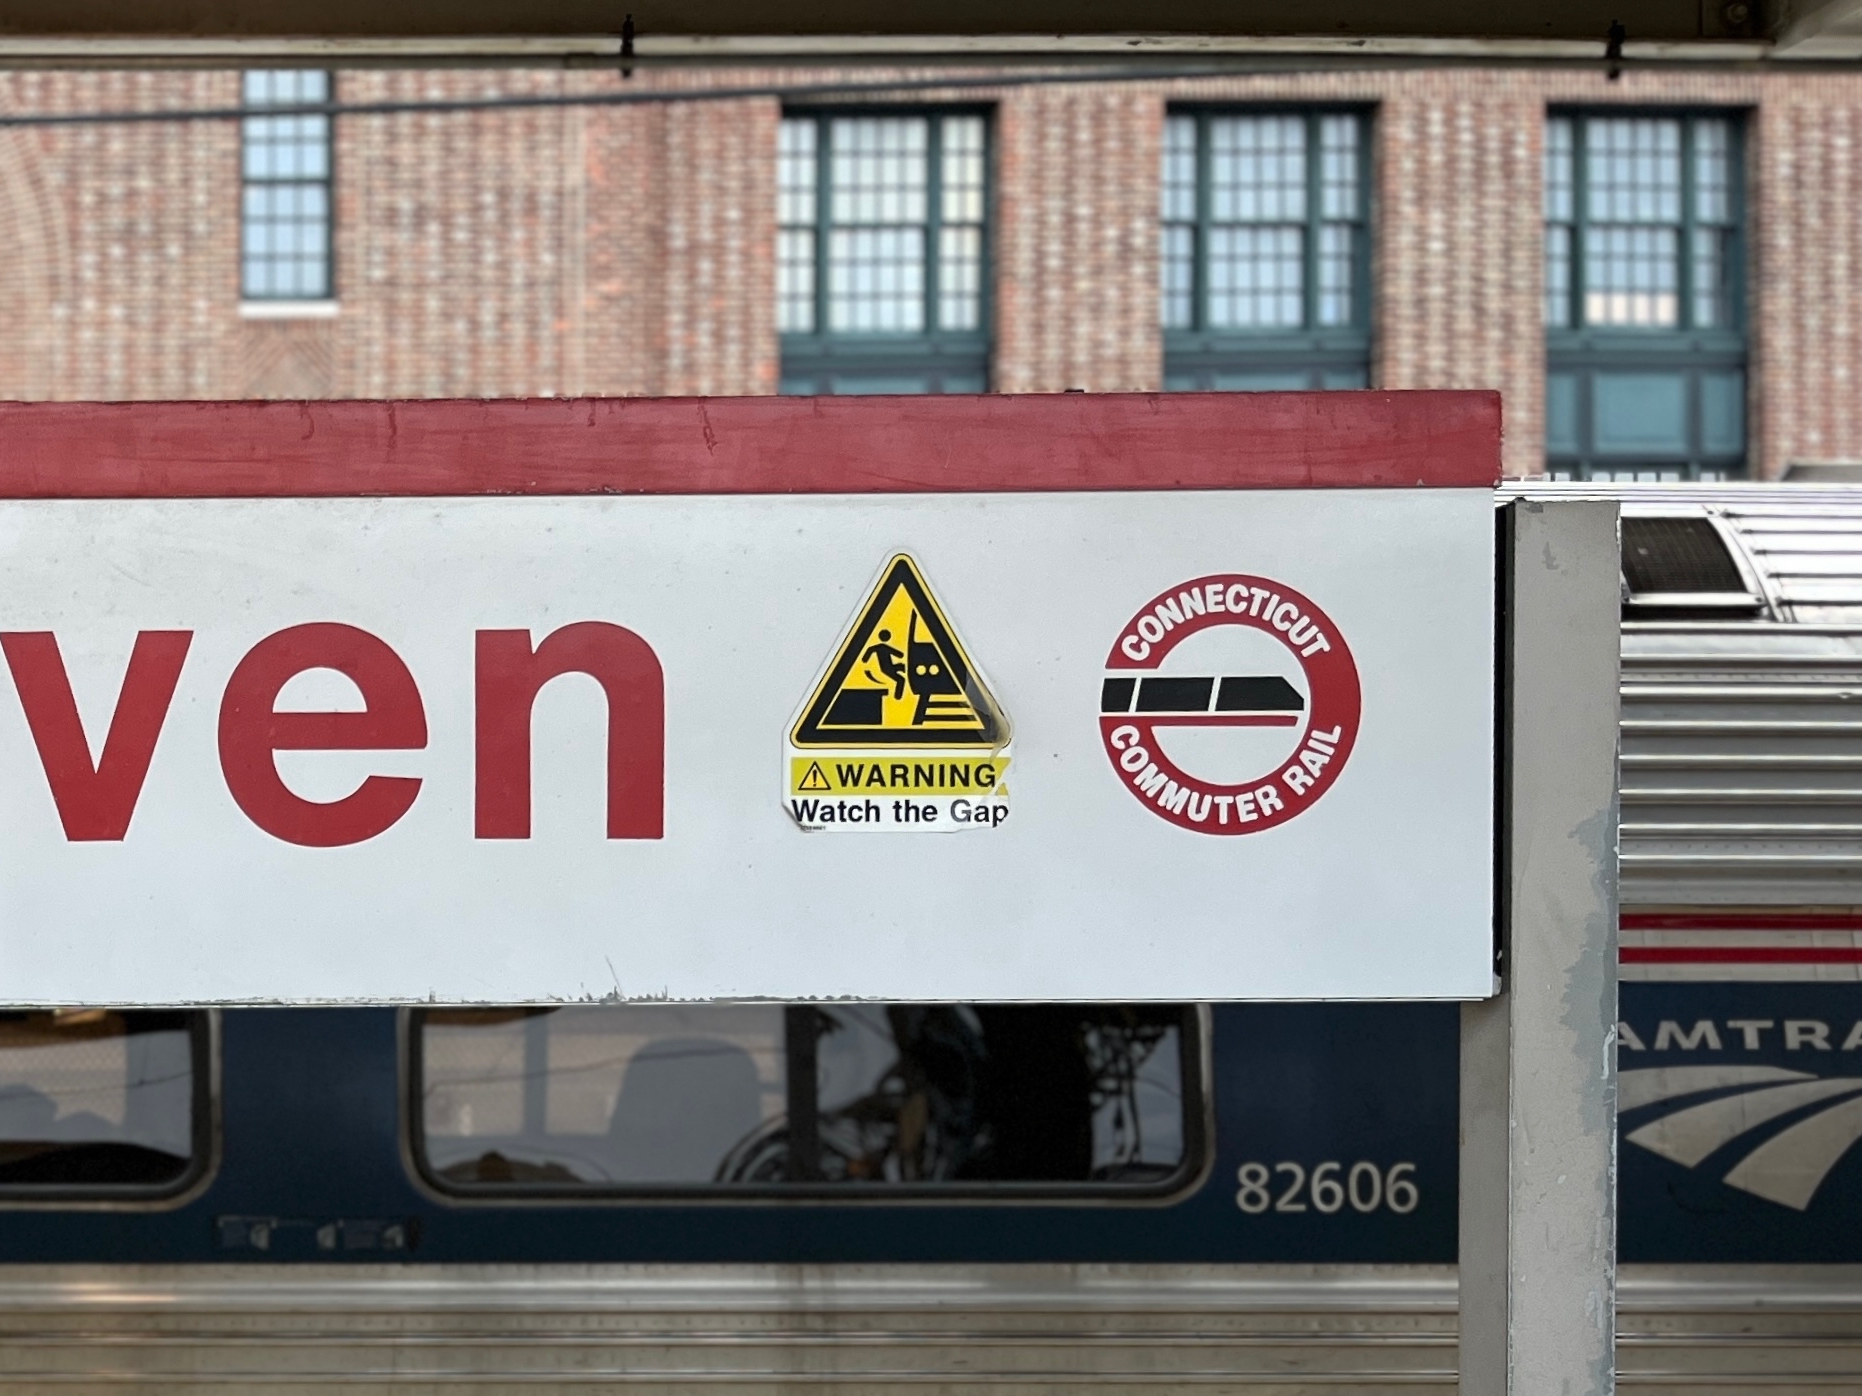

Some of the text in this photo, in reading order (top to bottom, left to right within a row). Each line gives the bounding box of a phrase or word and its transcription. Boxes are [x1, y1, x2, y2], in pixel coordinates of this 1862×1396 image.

[1121, 583, 1331, 661] CONNECTICUT
[835, 763, 996, 788] WARNING
[1110, 724, 1342, 825] COMMUTER RAIL
[791, 799, 1009, 828] Watch the Gap
[1237, 1162, 1418, 1213] 82606
